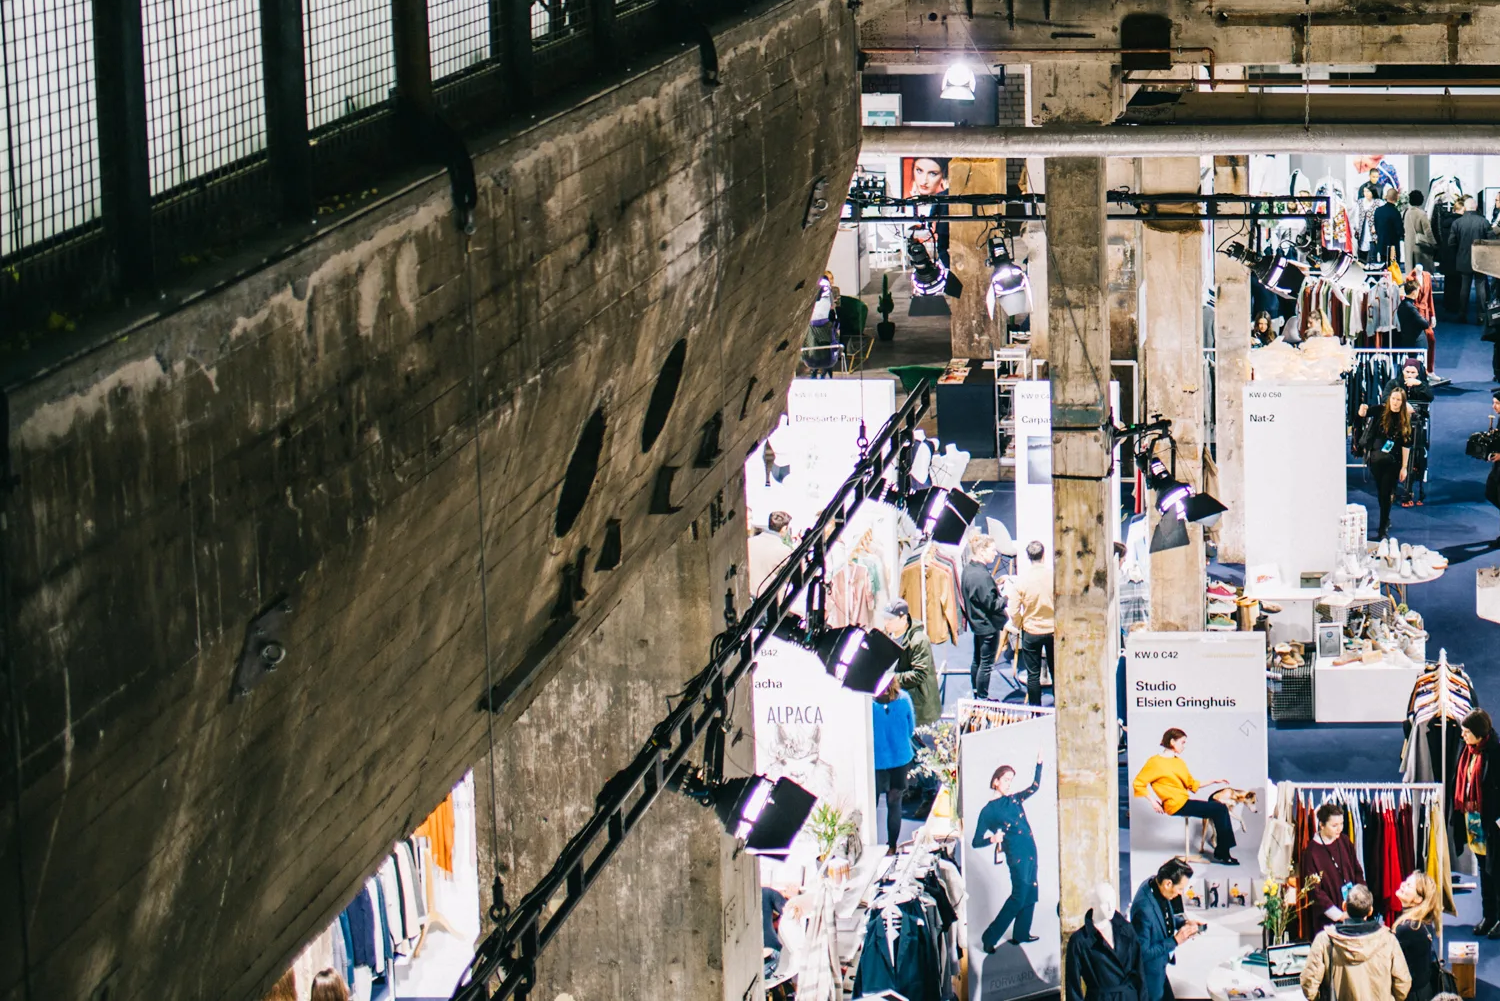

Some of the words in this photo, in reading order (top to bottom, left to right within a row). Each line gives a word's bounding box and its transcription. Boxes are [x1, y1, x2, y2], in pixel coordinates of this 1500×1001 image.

[1249, 414, 1275, 422] Nat-2
[1161, 651, 1179, 659] C42
[1136, 680, 1177, 691] Studio
[1136, 696, 1173, 707] Elsien
[1176, 696, 1236, 710] Gringhuis
[767, 705, 824, 724] ALPACA
